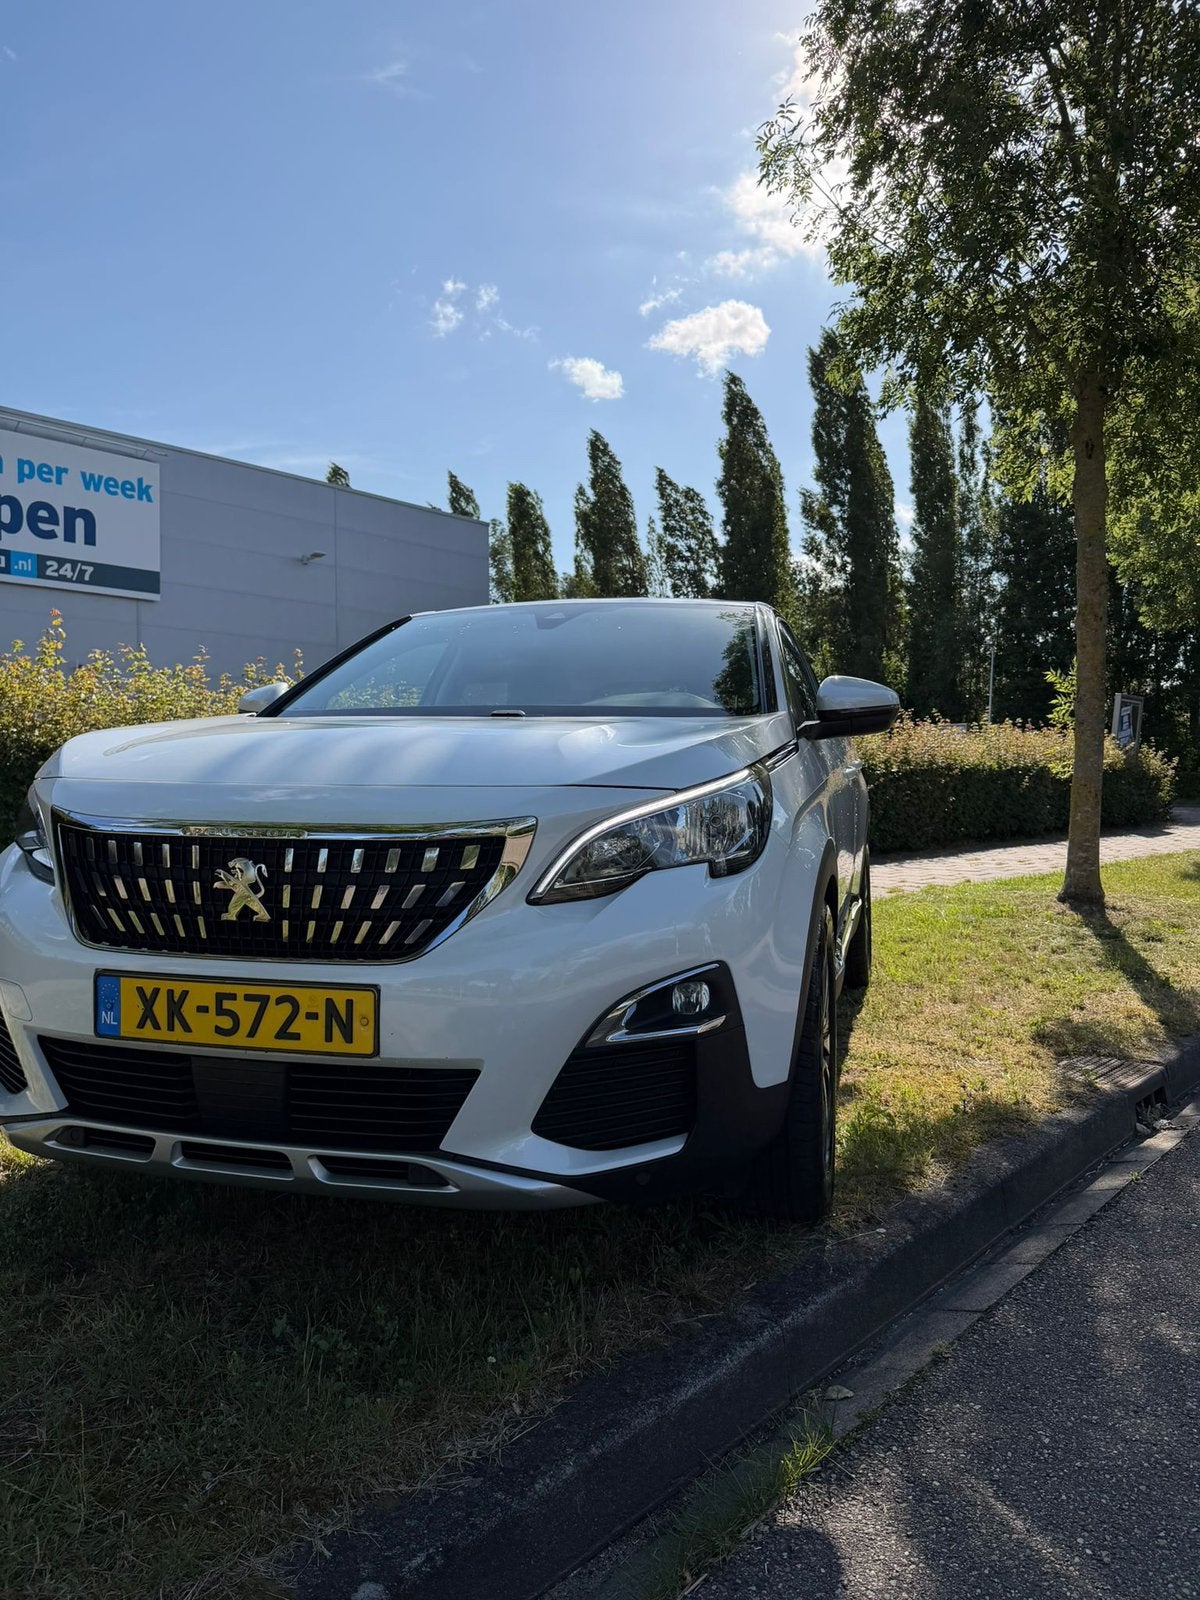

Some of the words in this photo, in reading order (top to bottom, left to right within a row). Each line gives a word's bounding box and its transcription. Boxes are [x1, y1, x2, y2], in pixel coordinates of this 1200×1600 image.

[17, 457, 69, 485] per
[80, 470, 154, 503] week
[45, 560, 94, 581] 24/7
[101, 1011, 118, 1025] NL
[135, 986, 354, 1043] XK-572-N
